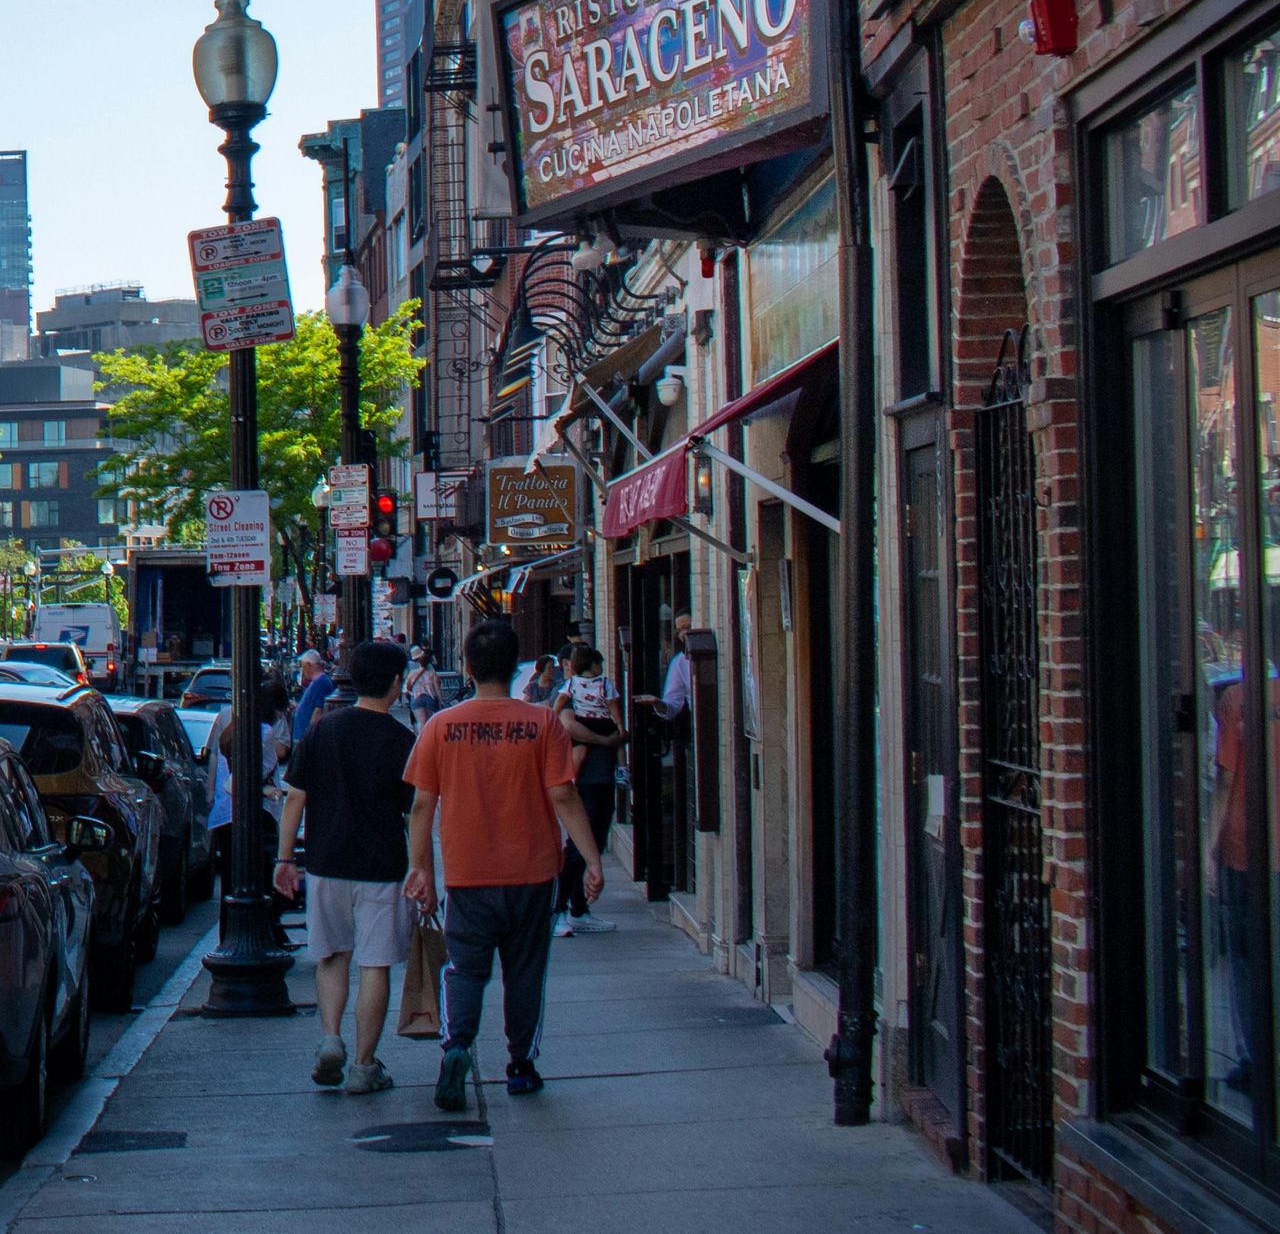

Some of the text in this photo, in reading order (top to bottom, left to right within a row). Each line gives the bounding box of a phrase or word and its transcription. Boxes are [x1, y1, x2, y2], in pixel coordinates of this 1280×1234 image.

[538, 62, 791, 184] CUCINA NAPOLETANA
[496, 474, 568, 491] Trattoria
[498, 493, 568, 510] Il Panino
[208, 521, 264, 533] Street Cleaning
[213, 562, 255, 571] Tow Zone
[444, 722, 468, 742] JUST
